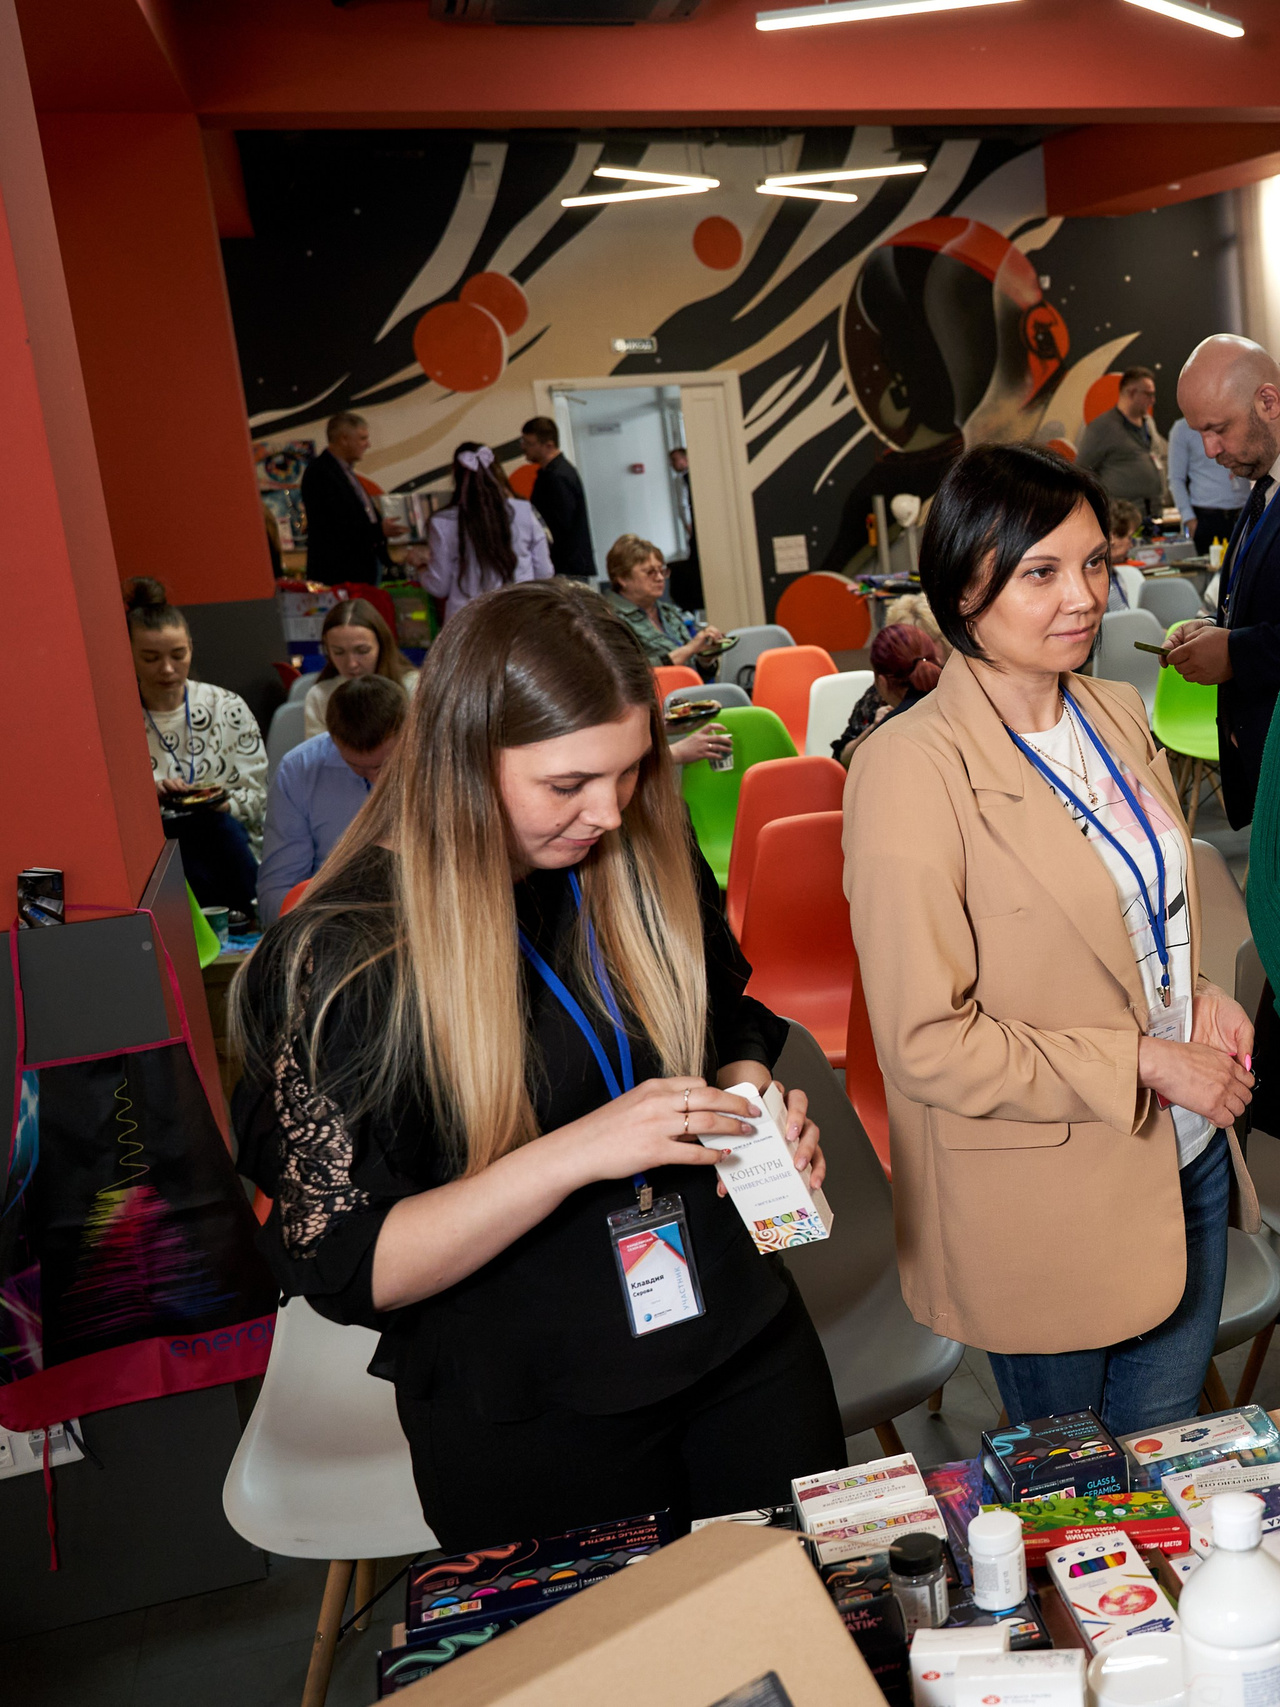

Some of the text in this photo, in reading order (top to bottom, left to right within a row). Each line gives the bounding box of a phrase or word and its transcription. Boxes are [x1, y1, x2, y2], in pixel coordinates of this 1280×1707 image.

[729, 1158, 784, 1183] КОНТУРЫ
[732, 1170, 793, 1194] УНИВЕРСАЛЬНЫЕ
[753, 1207, 809, 1232] DECOLA
[631, 1274, 665, 1290] Клавдия
[674, 1266, 690, 1311] УЧАСТНИК
[632, 1287, 654, 1298] Серова
[1083, 1483, 1121, 1498] CERAMICS
[1087, 1477, 1111, 1489] GLASS
[579, 1526, 658, 1547] ACRYLIC TEXTILE
[626, 1534, 660, 1545] ТКАНИ
[1065, 1529, 1124, 1542] ЛАСТИЛИН
[541, 1581, 578, 1595] CREATIVE
